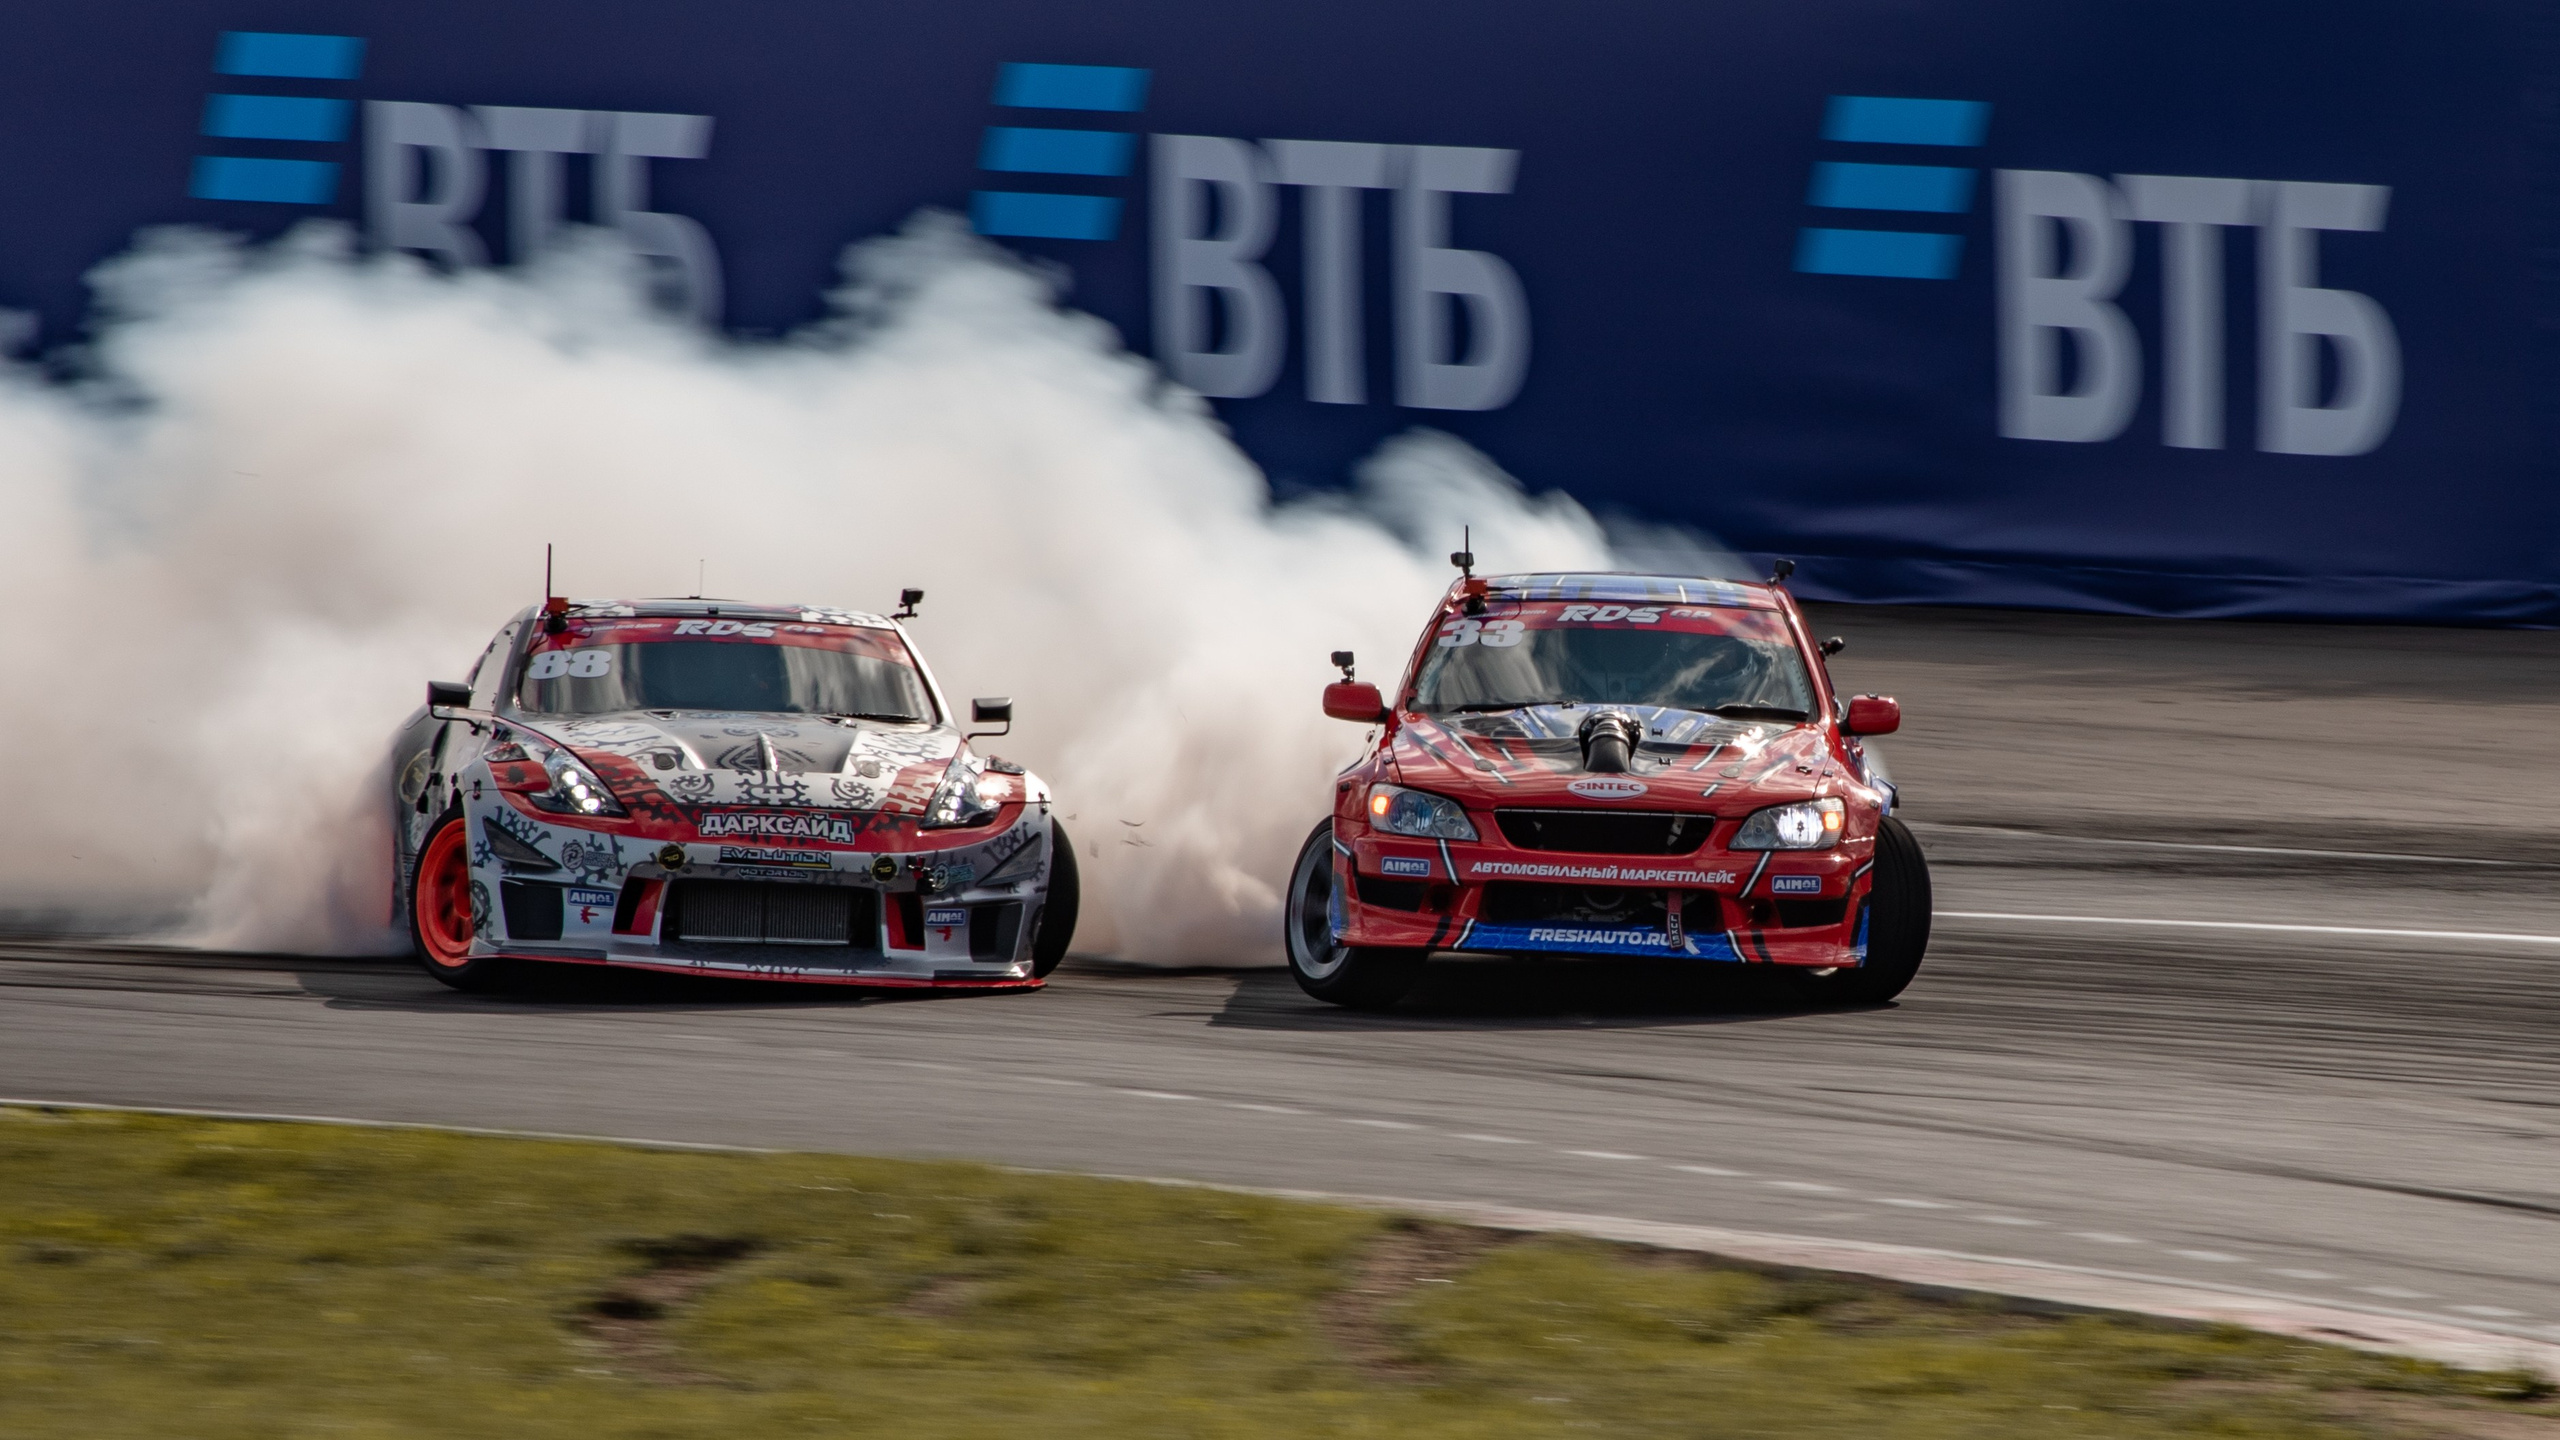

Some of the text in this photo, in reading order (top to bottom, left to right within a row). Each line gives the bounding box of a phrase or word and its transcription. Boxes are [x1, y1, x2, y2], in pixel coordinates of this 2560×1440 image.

[362, 99, 724, 328] ВТБ
[1148, 132, 1532, 411] ВТБ
[1993, 168, 2404, 457] ВТБ
[1557, 605, 1669, 623] RDS
[673, 620, 780, 638] RDS
[1438, 619, 1525, 648] 33
[527, 650, 612, 679] 88
[1574, 781, 1641, 793] SINTEC
[701, 813, 852, 844] ДАРКСАЙД
[721, 847, 831, 864] EVOLUTION
[1383, 859, 1427, 873] AIMOL
[1471, 861, 1736, 884] АВТОМОБИЛЬНЫЙ МАРКЕТПЛЕЙС
[1774, 876, 1819, 890] AIMOL
[570, 891, 613, 904] AIMOL
